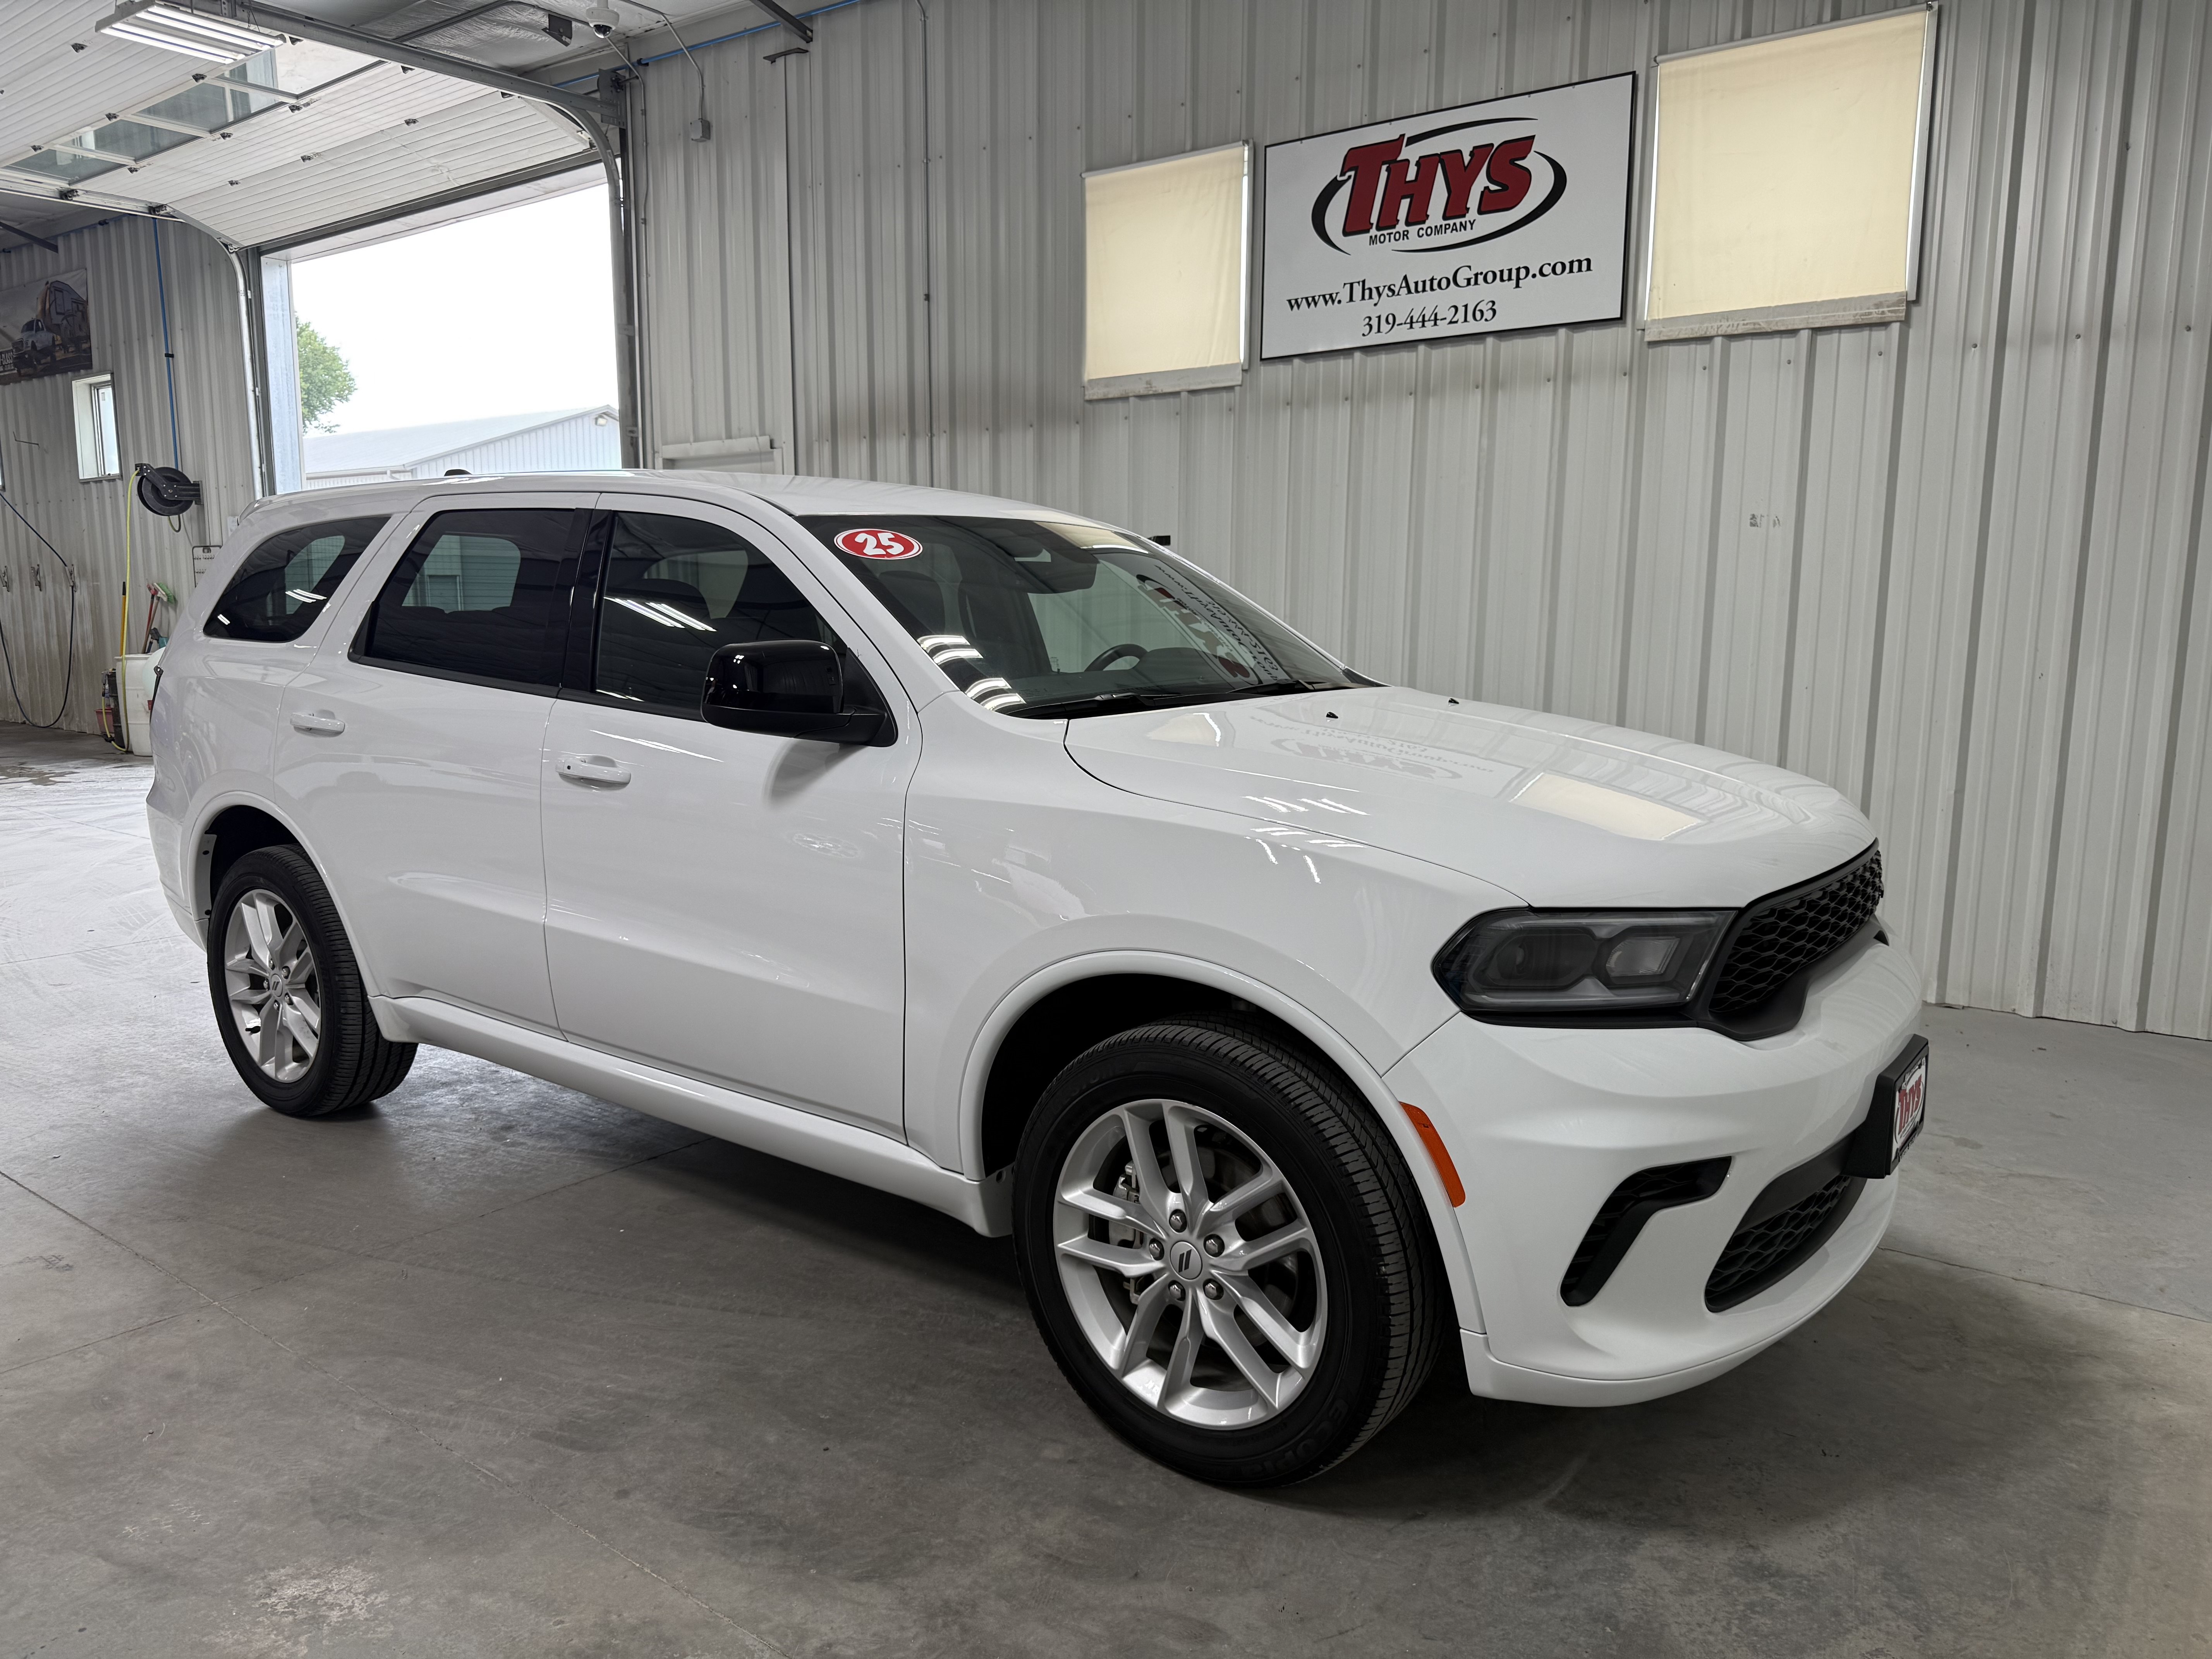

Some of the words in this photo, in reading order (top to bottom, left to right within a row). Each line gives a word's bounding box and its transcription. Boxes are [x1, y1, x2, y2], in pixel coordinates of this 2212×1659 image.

[1340, 133, 1536, 237] THYS
[1369, 230, 1410, 246] MOTOR
[1417, 219, 1476, 238] COMPANY
[1286, 258, 1593, 311] www.ThysAutoGroup.com
[1362, 299, 1497, 337] 319-444-2163
[854, 532, 904, 555] 25
[1898, 1074, 1922, 1135] THYS
